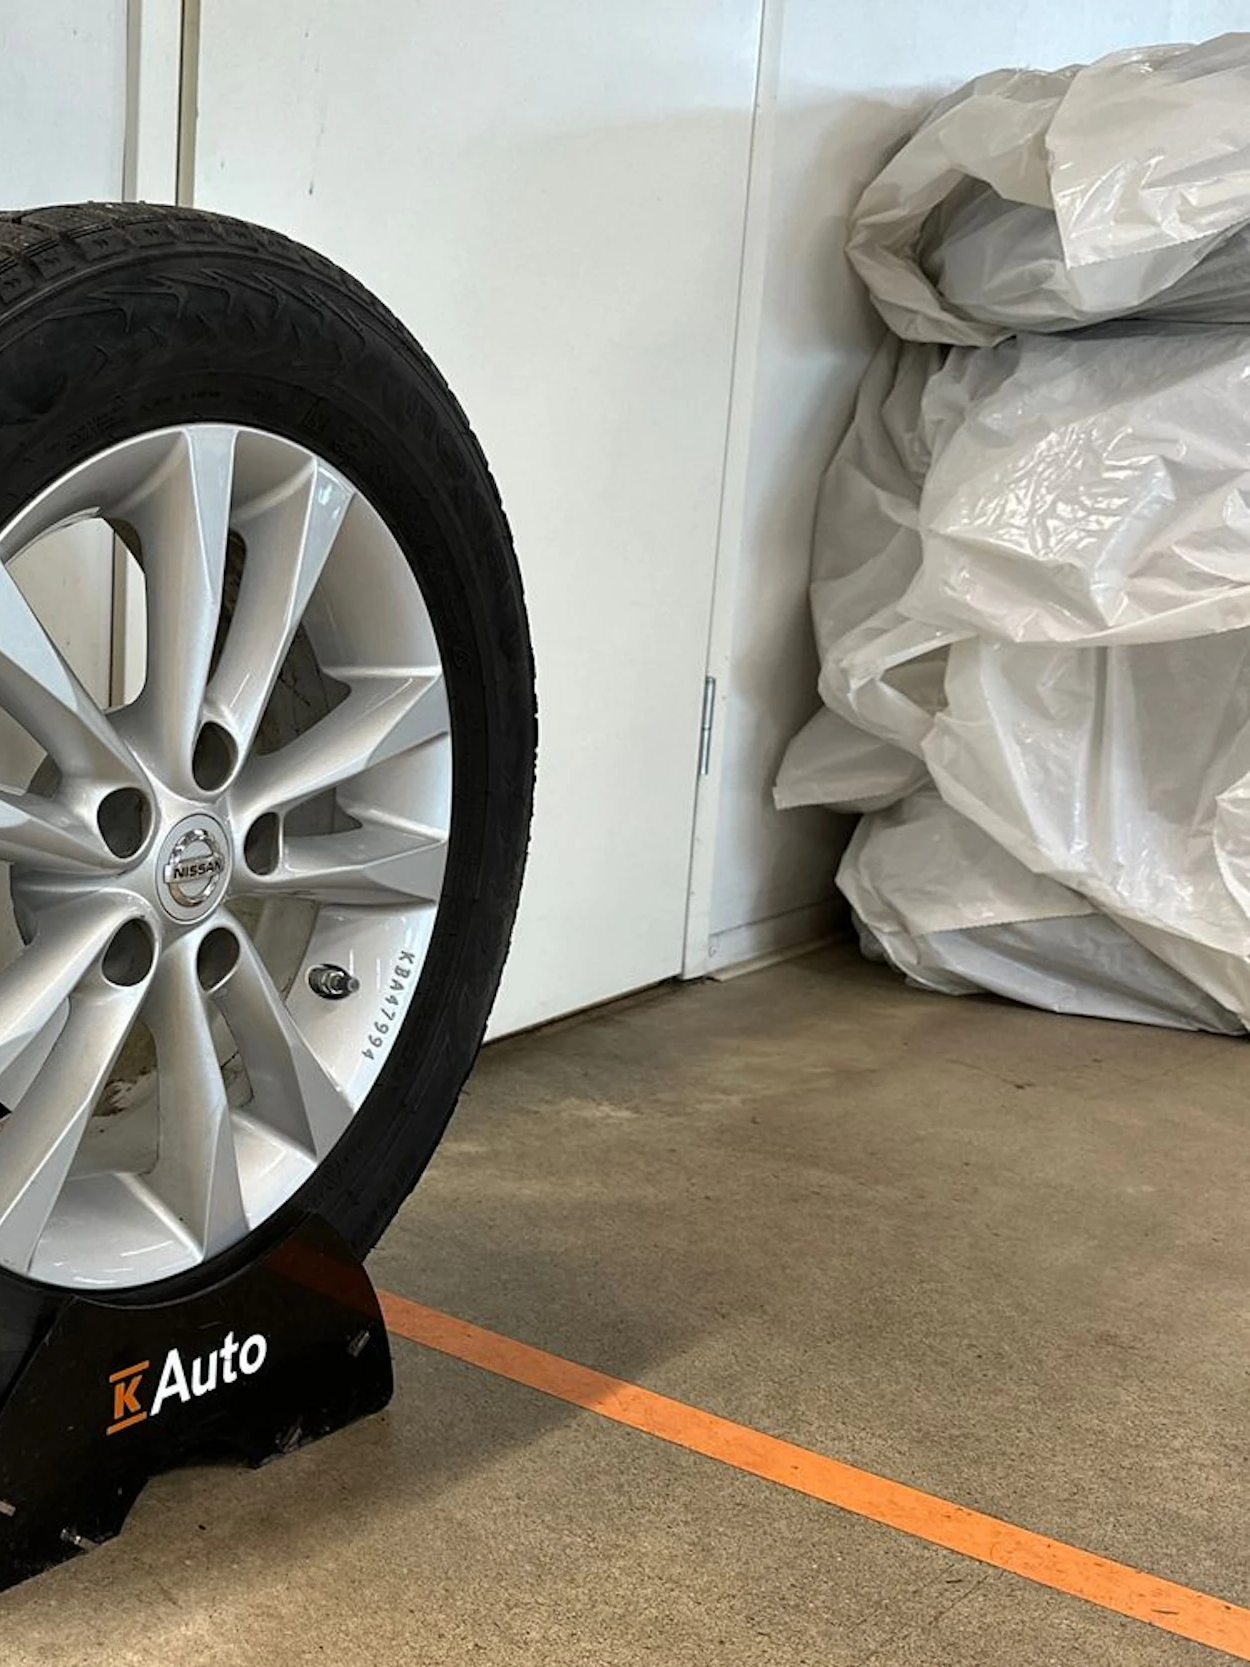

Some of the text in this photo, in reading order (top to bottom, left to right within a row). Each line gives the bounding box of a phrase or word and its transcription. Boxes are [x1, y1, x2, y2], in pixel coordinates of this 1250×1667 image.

[174, 861, 221, 878] NISSAN
[361, 950, 415, 1061] KBA47994
[150, 1330, 268, 1417] Auto
